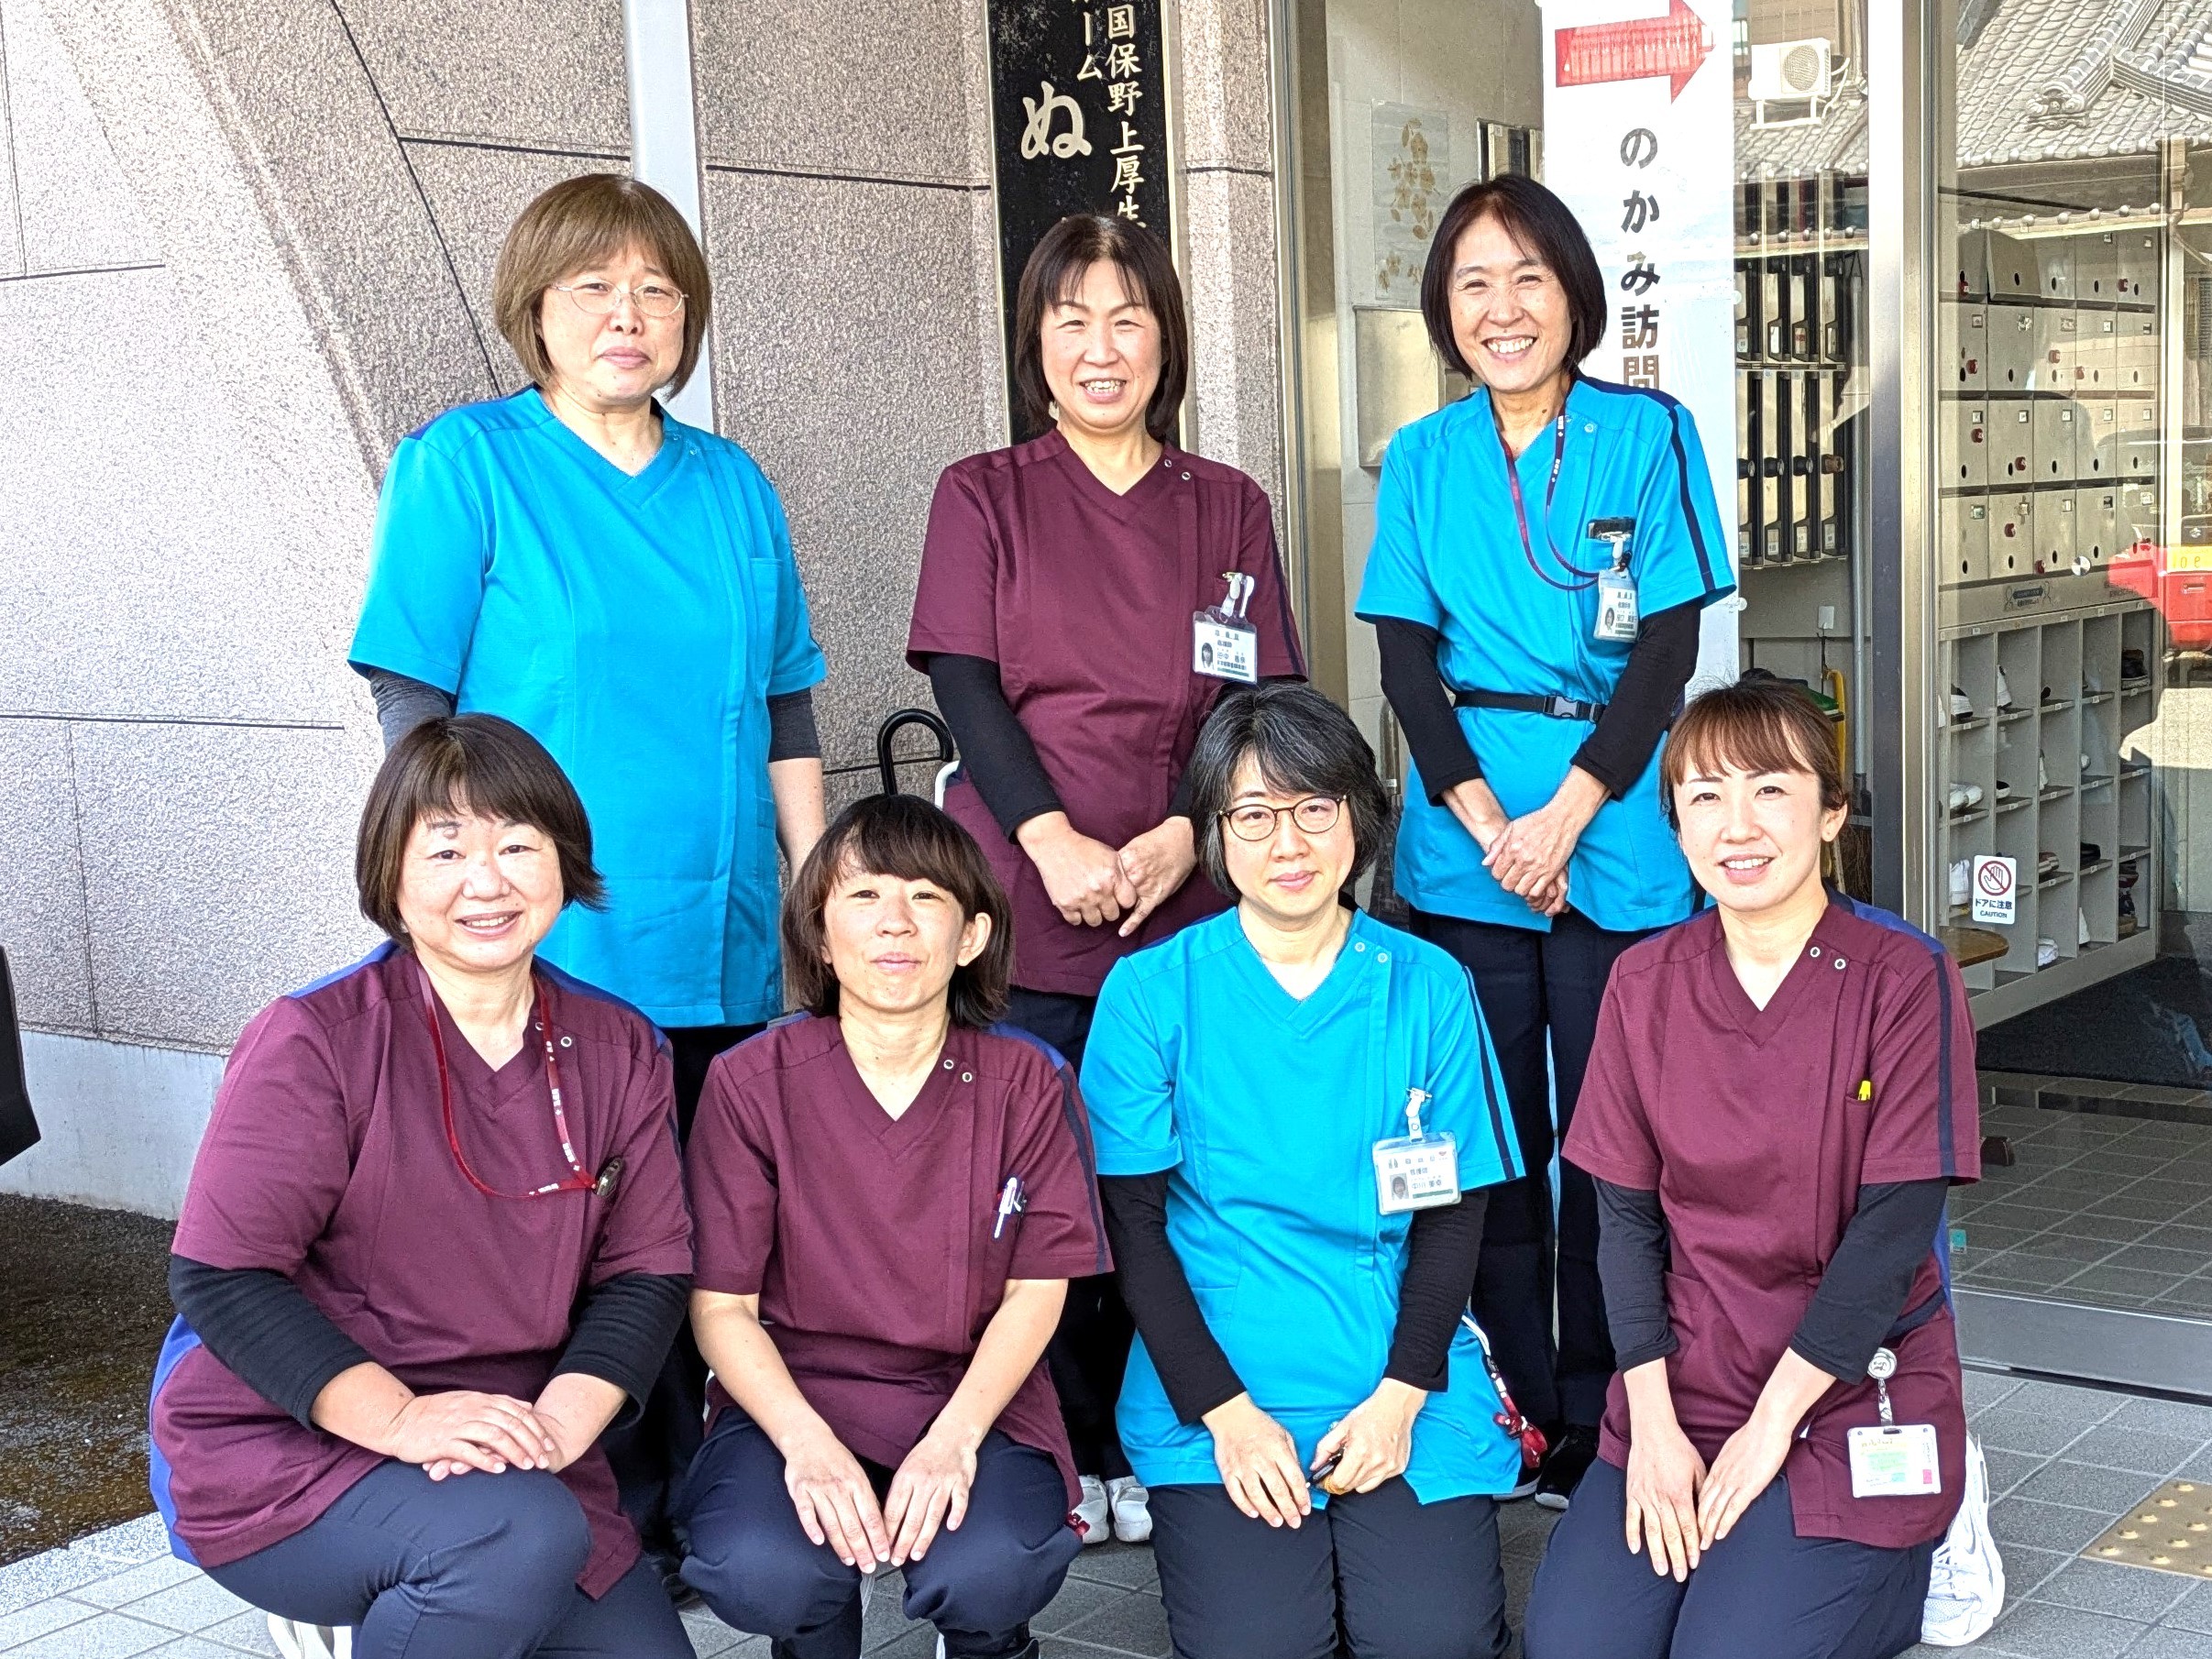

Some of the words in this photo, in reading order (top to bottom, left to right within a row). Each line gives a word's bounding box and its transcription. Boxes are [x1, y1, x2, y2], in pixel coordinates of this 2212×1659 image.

[1072, 0, 1103, 82] ーム
[1105, 4, 1146, 228] 国保野上厚生
[1620, 127, 1660, 390] のかみ訪問
[1975, 898, 2013, 910] ドアに注意
[1979, 909, 2008, 918] CAUTION
